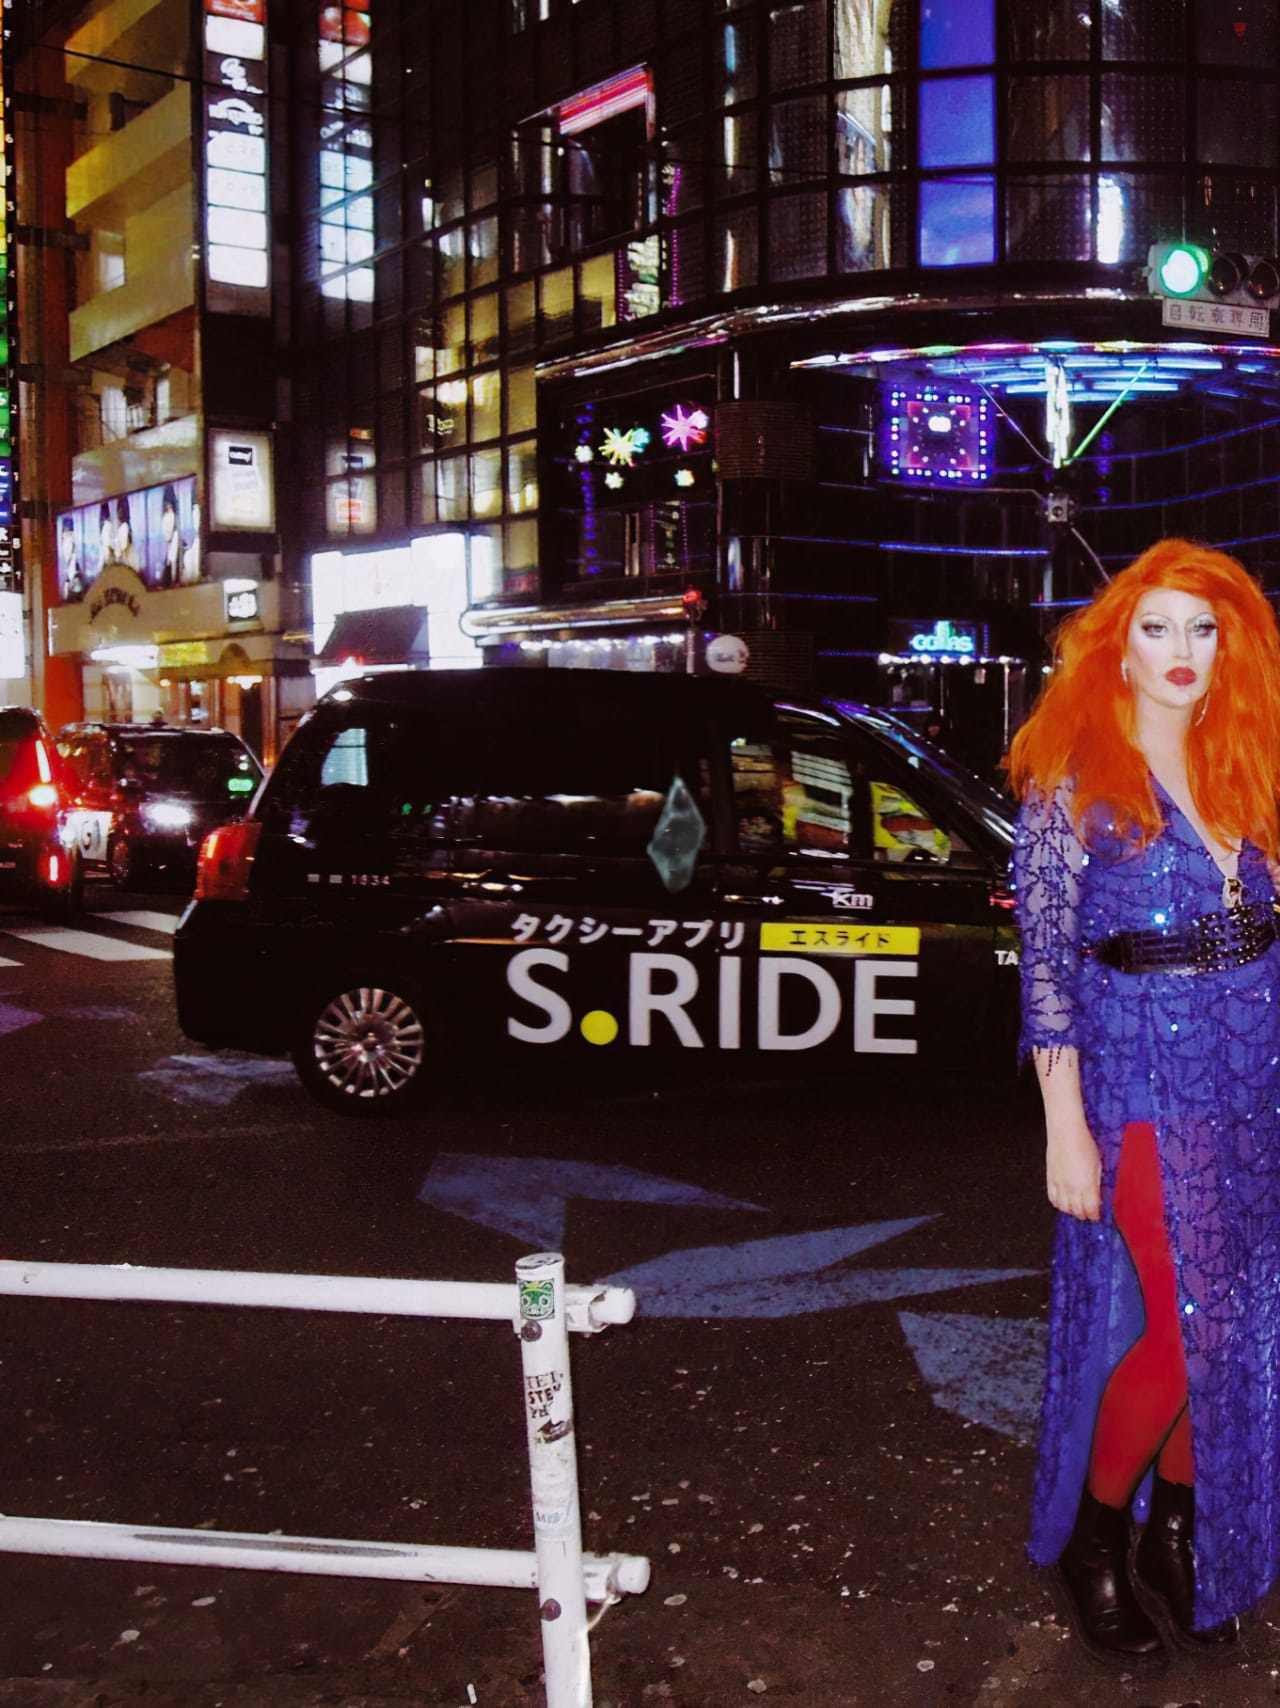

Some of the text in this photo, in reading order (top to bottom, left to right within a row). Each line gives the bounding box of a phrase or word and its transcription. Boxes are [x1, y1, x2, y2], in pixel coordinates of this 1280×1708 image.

[510, 912, 744, 949] タクシーアプリ
[788, 929, 891, 949] エスライド
[506, 947, 919, 1055] S.RIDE
